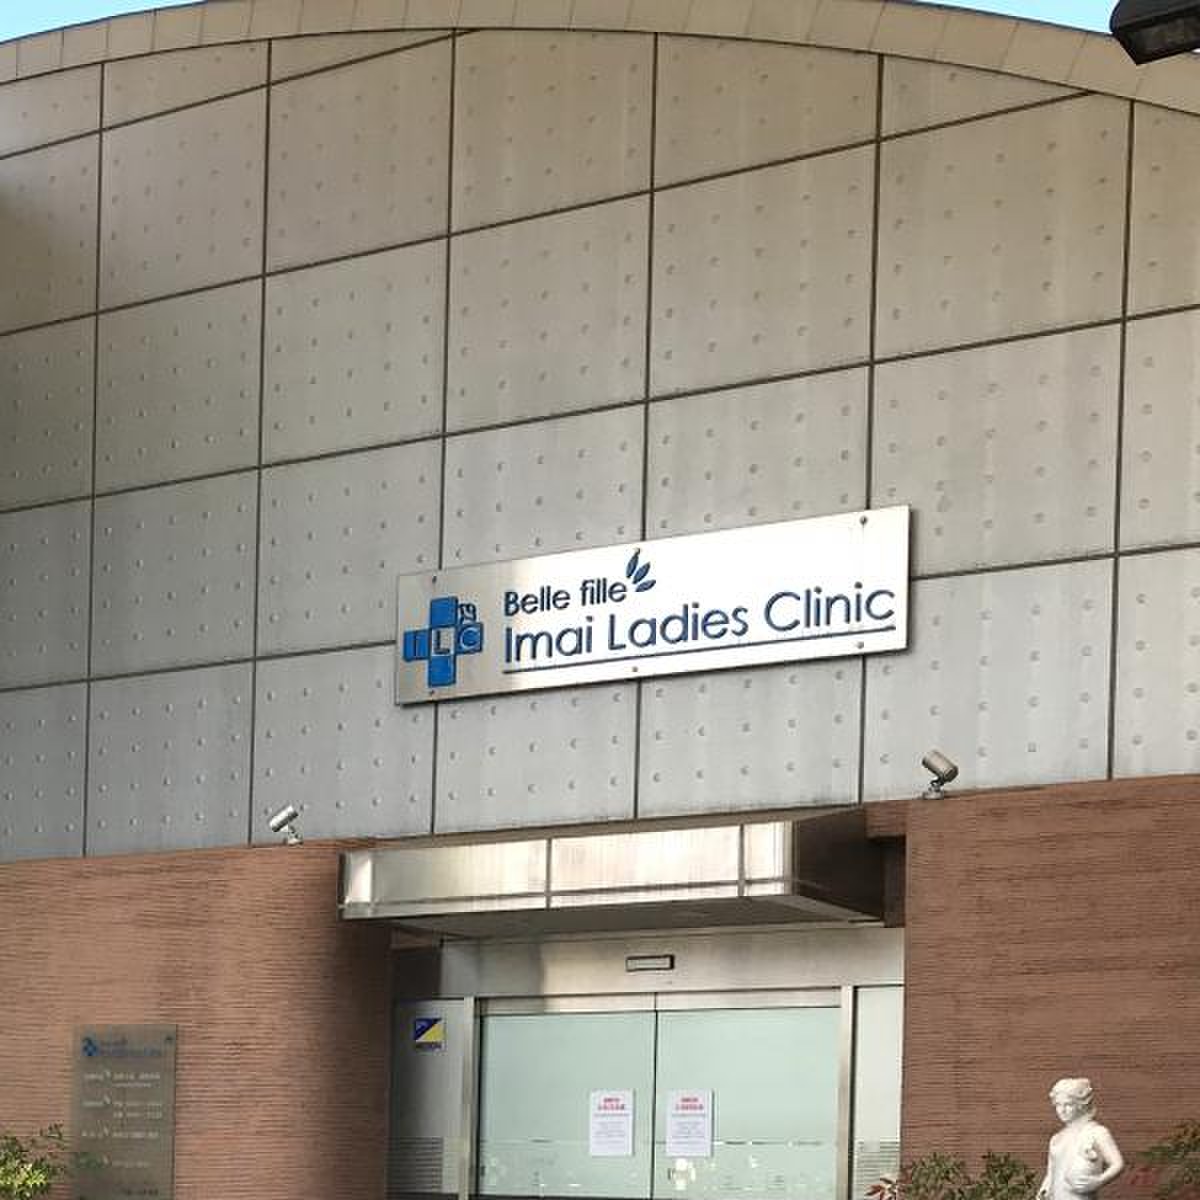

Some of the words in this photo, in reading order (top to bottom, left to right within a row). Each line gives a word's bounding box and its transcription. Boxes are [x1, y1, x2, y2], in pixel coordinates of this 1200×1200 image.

[504, 584, 571, 616] Belle
[580, 577, 627, 607] fille
[504, 615, 593, 663] Imai
[608, 602, 749, 650] Ladies
[764, 581, 896, 632] Clinic
